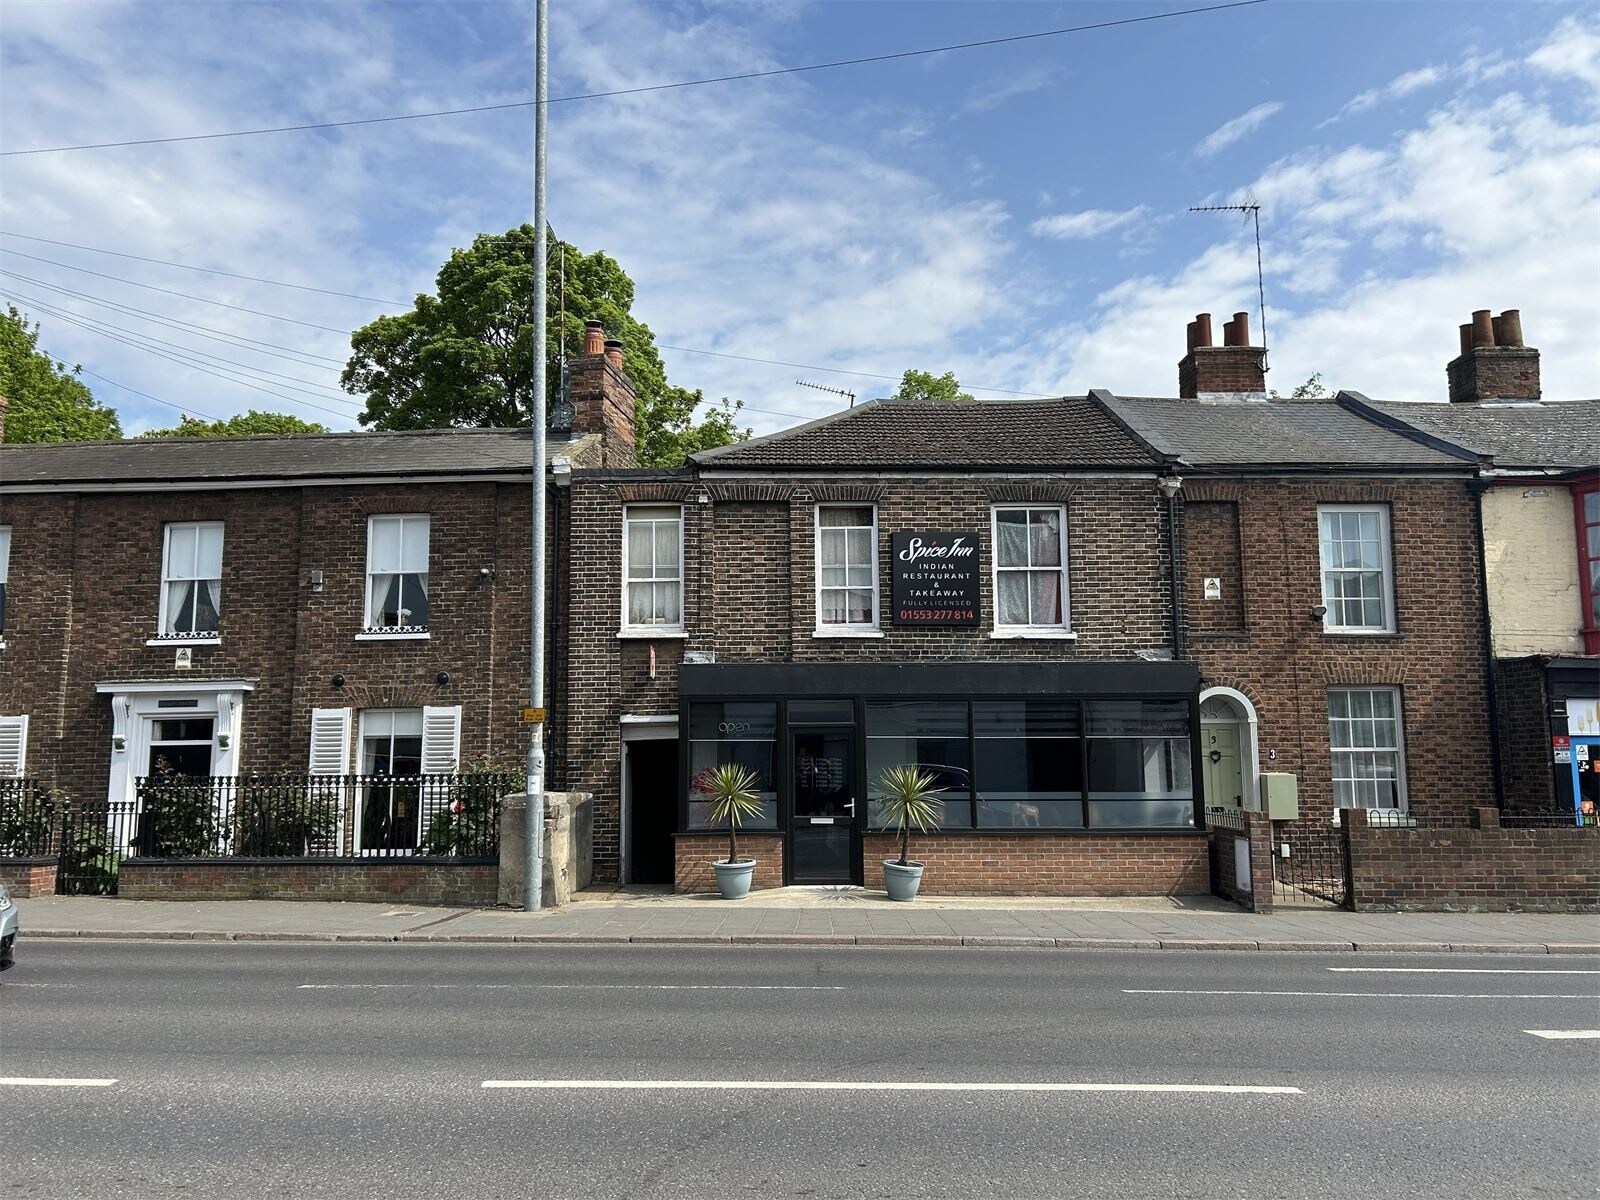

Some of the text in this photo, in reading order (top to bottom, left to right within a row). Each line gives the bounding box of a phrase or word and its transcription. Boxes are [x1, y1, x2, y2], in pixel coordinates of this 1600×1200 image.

[899, 536, 974, 564] Spice Inn
[718, 722, 750, 734] open
[1269, 748, 1276, 760] 3
